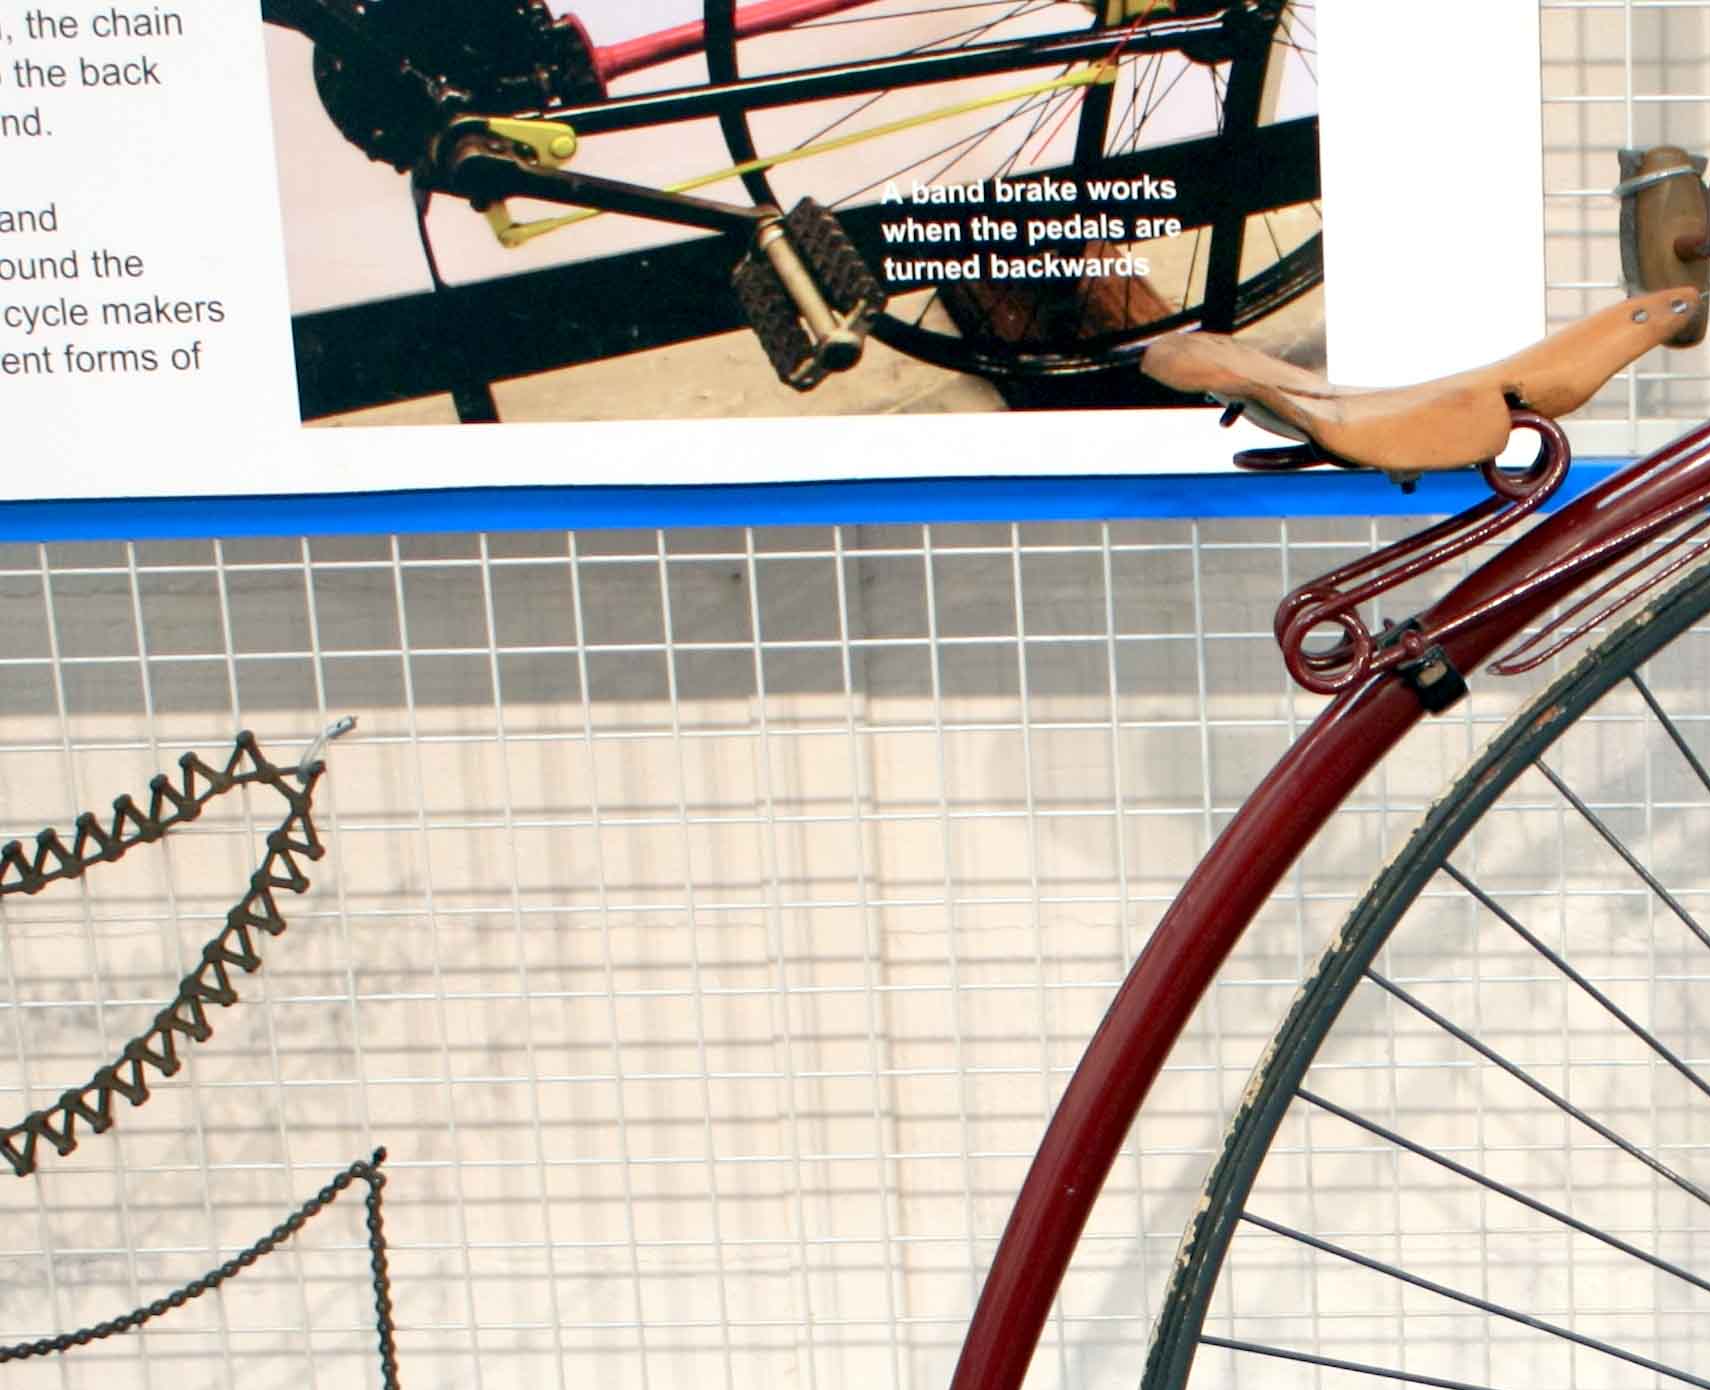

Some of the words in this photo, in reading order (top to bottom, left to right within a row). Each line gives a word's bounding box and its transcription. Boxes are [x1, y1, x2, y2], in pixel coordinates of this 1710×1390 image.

[25, 9, 78, 39] the
[92, 7, 183, 38] chain
[13, 59, 66, 88] the
[79, 55, 161, 87] back
[881, 182, 903, 204] A
[911, 178, 984, 204] band
[994, 176, 1078, 203] brake
[1086, 174, 1177, 200] works
[0, 203, 58, 233] and
[881, 217, 961, 243] when
[970, 215, 1018, 241] the
[1028, 213, 1125, 246] pedals
[1134, 217, 1182, 238] are
[91, 249, 143, 278] the
[884, 254, 981, 281] turned
[990, 250, 1151, 279] backwards
[4, 297, 88, 335] cycle
[102, 295, 225, 325] makers
[63, 343, 159, 373] forms
[171, 340, 203, 371] of
